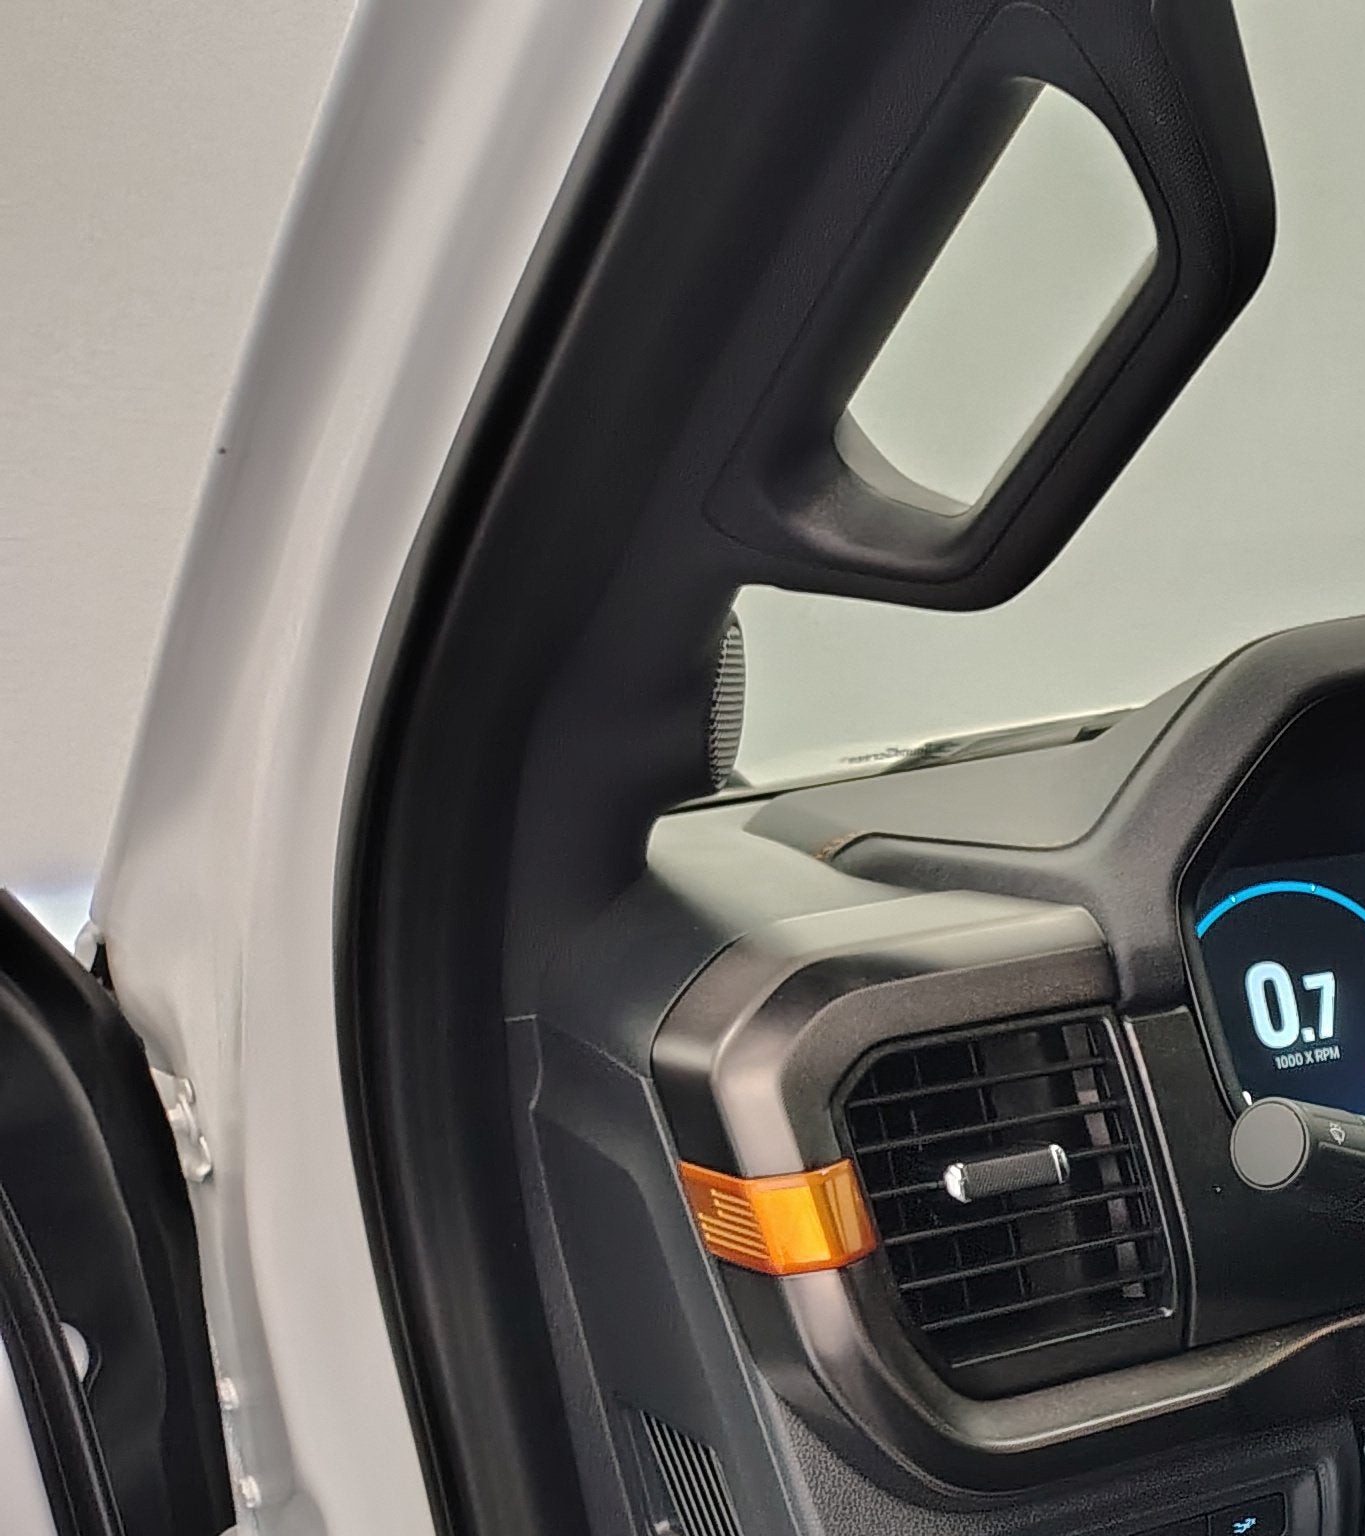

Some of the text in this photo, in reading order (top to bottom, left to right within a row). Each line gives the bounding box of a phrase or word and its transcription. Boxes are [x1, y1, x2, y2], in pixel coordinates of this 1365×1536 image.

[1243, 961, 1336, 1050] 0.7
[1273, 1054, 1302, 1070] 1000
[1314, 1046, 1341, 1062] RPM
